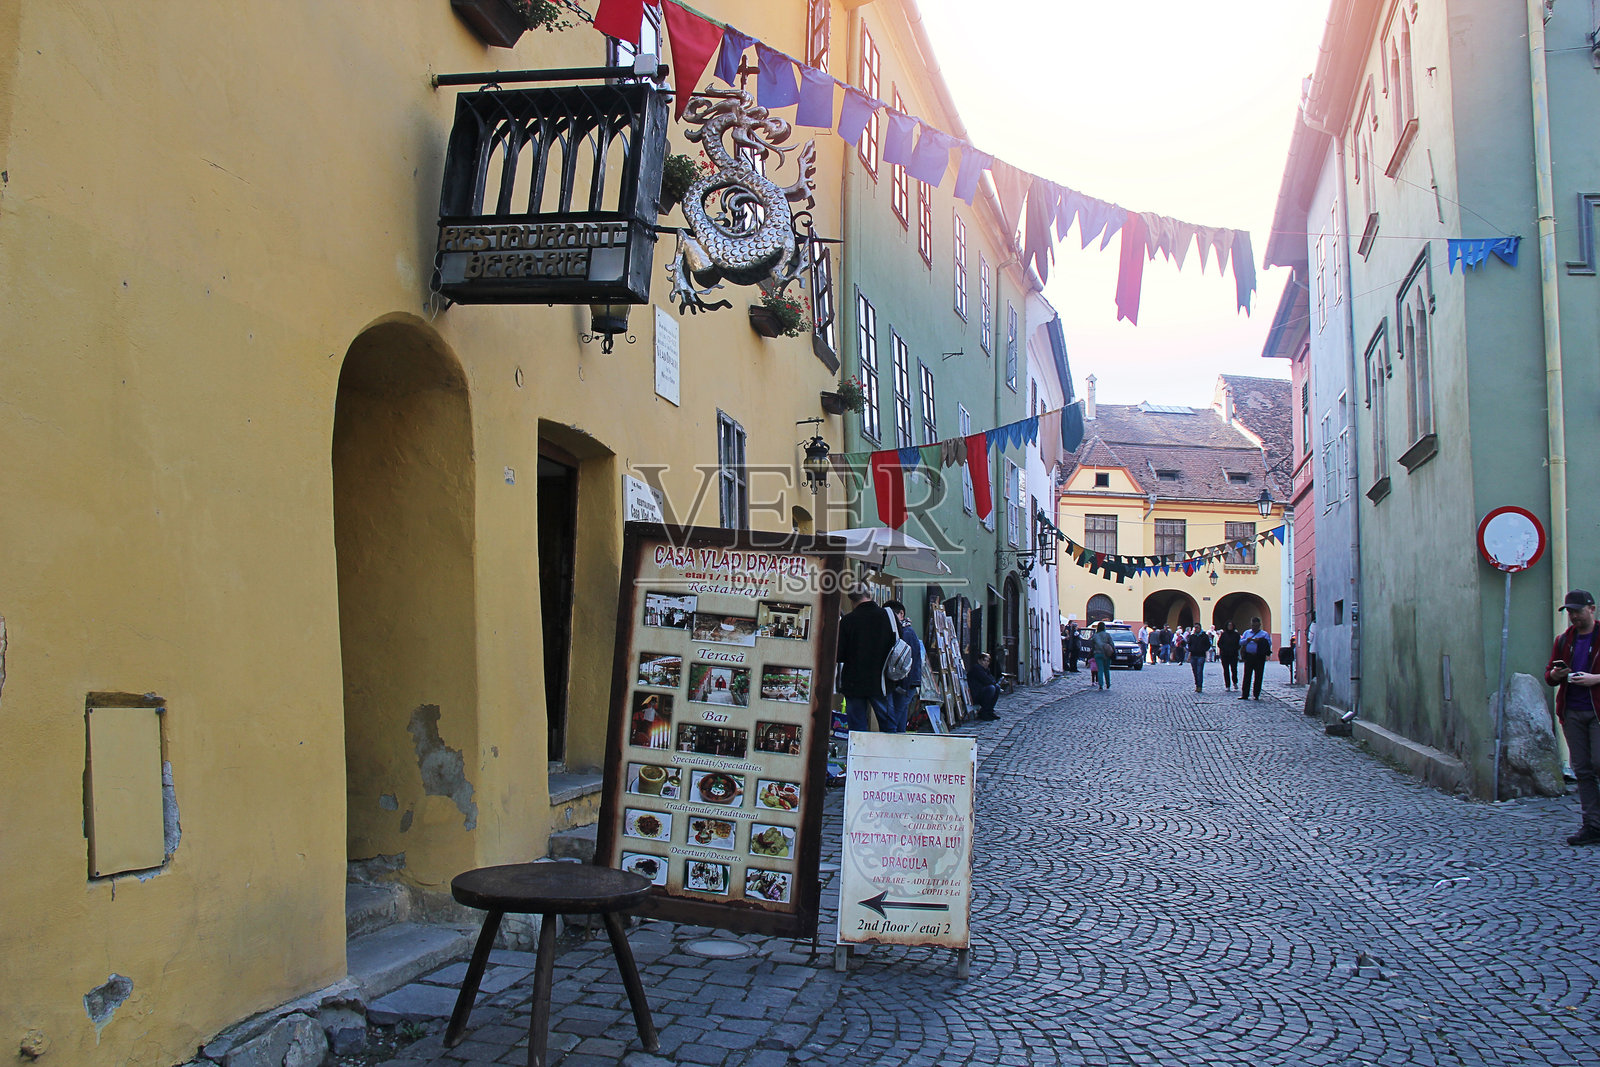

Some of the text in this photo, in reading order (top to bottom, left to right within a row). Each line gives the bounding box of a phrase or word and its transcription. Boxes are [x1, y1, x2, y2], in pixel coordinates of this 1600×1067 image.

[440, 223, 622, 250] RESTAURANT
[464, 252, 587, 279] BERARIE
[654, 546, 809, 578] CASA VLAD DRACUL
[688, 581, 770, 598] Restaurant
[697, 648, 745, 663] Terasă
[701, 710, 729, 723] Bar
[854, 770, 966, 785] VISIT THE ROOM WHERE
[863, 790, 956, 804] DRACULA WAS BORN
[868, 811, 910, 820] ENTRANCE
[908, 823, 946, 831] CHILDREN
[900, 834, 942, 847] CAMERA
[946, 836, 961, 848] LUI
[882, 856, 928, 870] DRACULA
[872, 876, 905, 884] INTRARE
[857, 919, 880, 931] 2nd
[880, 920, 910, 934] floor
[920, 923, 941, 936] etaj
[944, 924, 950, 934] 2
